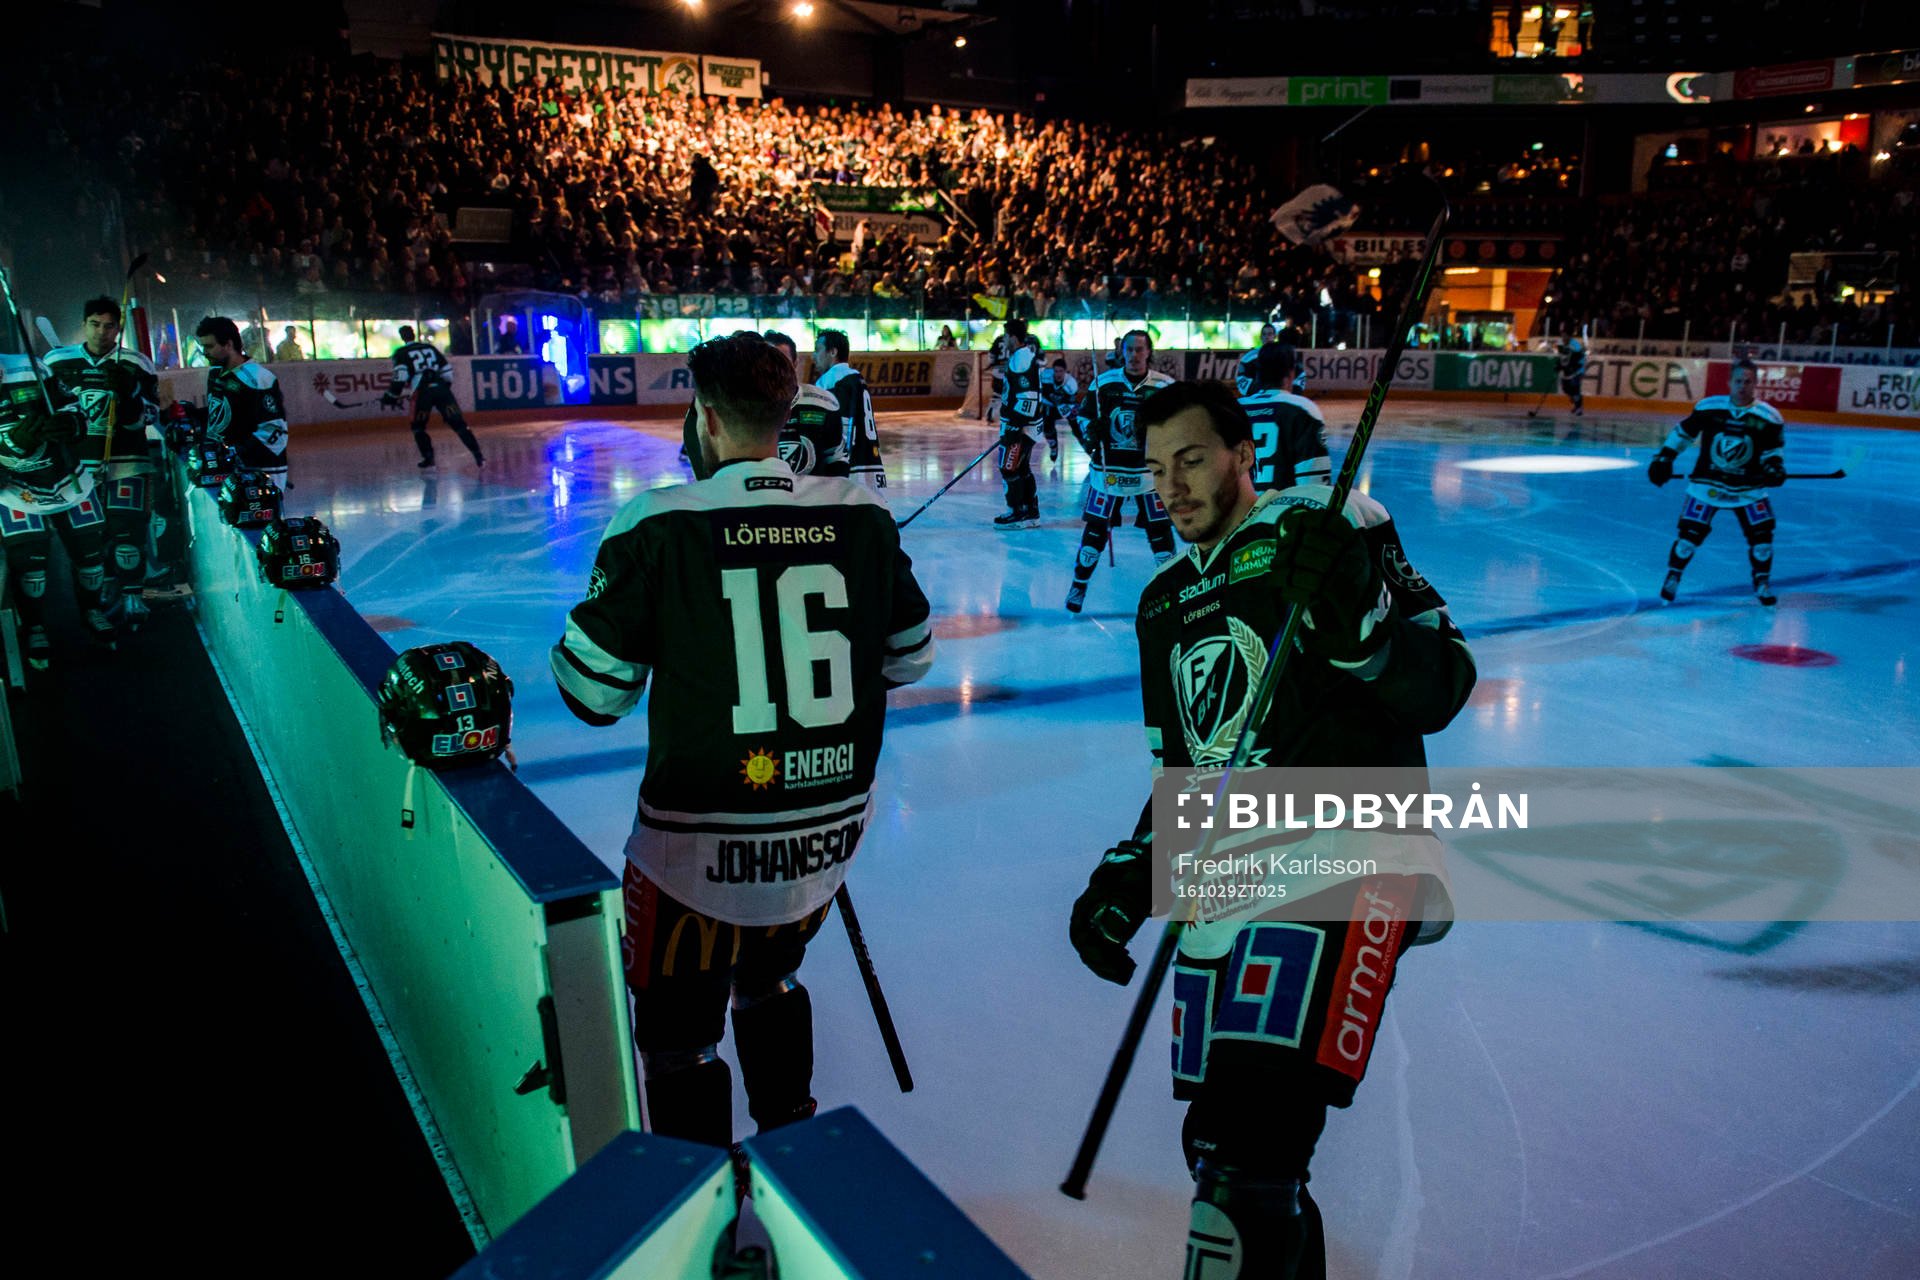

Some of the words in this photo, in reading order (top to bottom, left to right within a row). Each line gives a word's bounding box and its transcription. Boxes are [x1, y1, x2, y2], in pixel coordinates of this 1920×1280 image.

[431, 36, 662, 97] BRYGGERIET
[1299, 77, 1376, 102] print
[407, 346, 440, 372] 22
[1467, 360, 1534, 388] OCAY!
[748, 477, 793, 491] CCM
[723, 523, 837, 547] LÖFBERGS
[282, 562, 326, 579] ELON
[297, 553, 311, 564] 16
[1178, 572, 1226, 604] stadium
[1183, 599, 1222, 625] LÖFBERGS
[720, 563, 855, 735] 16
[455, 714, 475, 733] 13
[432, 726, 500, 756] ELON
[784, 742, 855, 781] ENERGI
[706, 818, 864, 883] JOHANSSON
[1336, 891, 1395, 1062] armat
